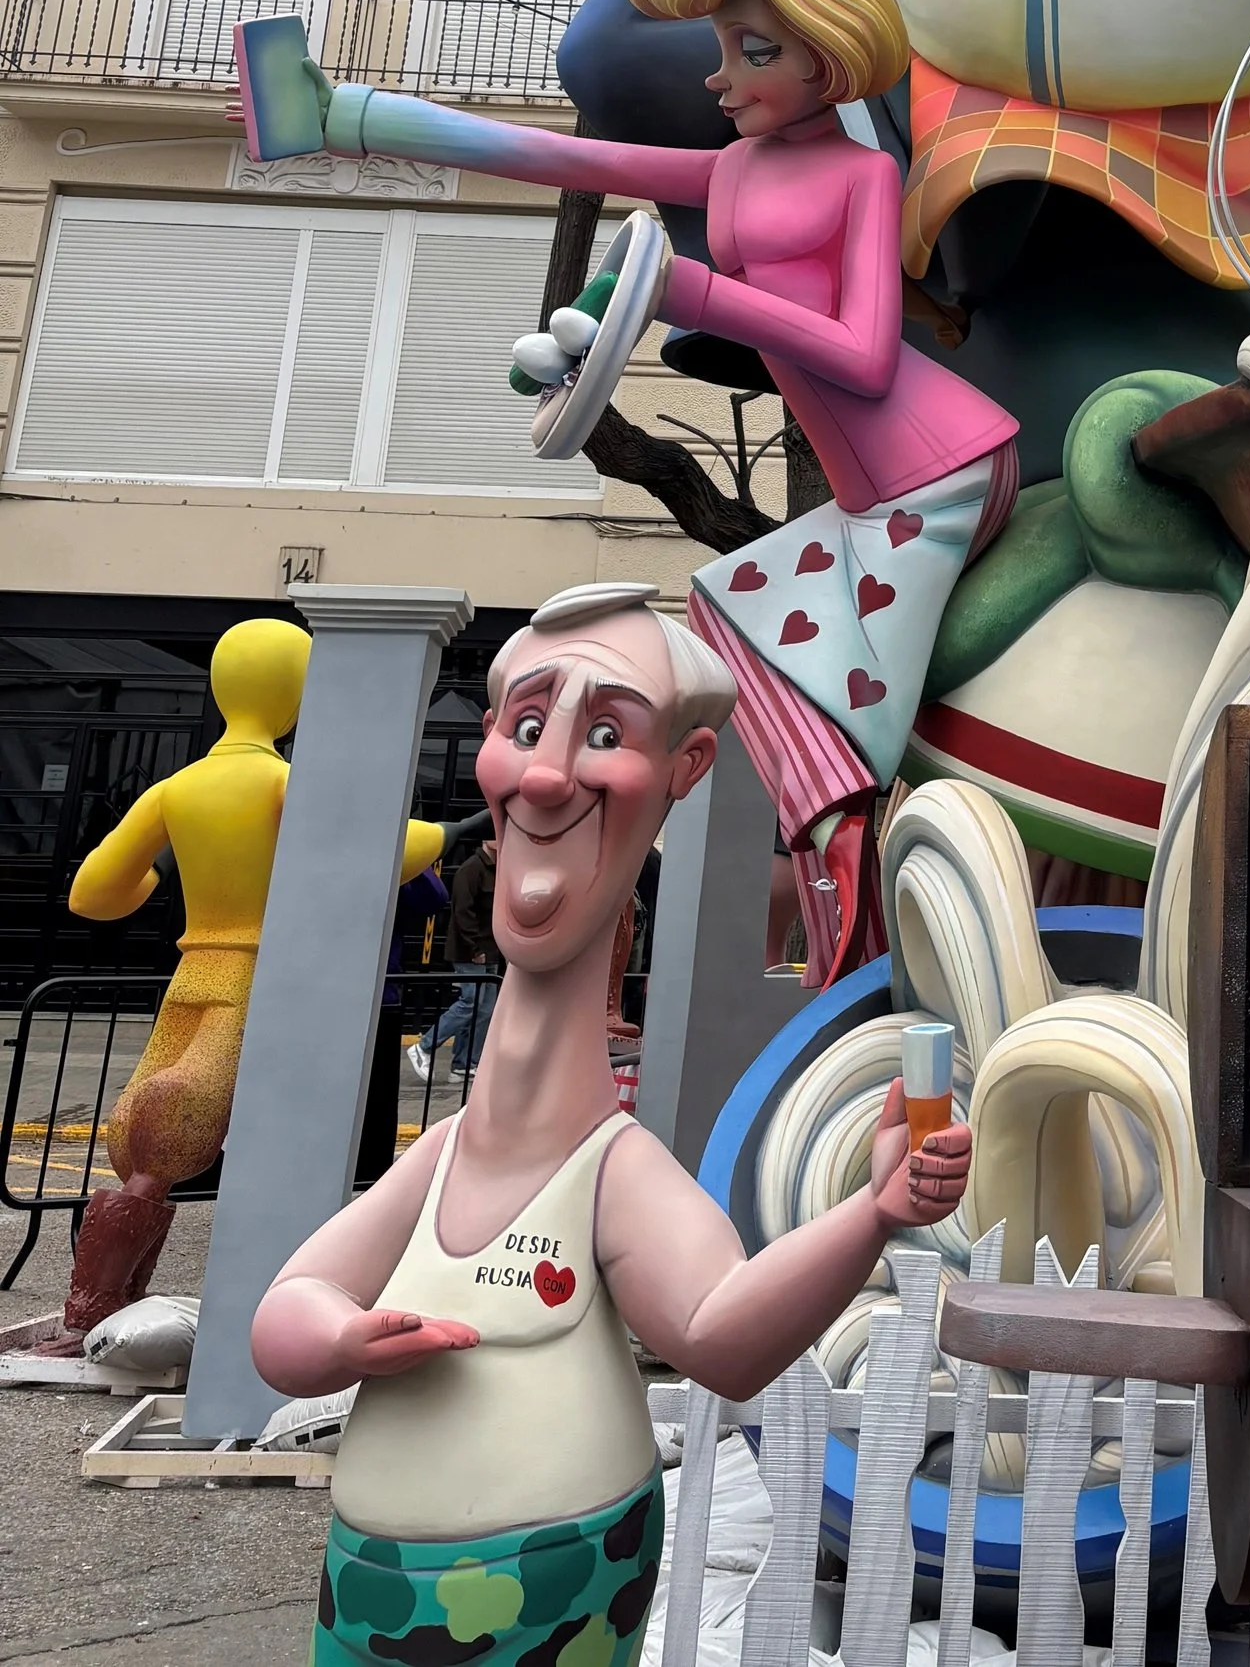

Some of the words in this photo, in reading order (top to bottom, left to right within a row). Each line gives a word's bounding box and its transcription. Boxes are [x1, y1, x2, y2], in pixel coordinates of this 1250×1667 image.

[282, 557, 314, 584] 14
[505, 1233, 561, 1259] DESDE
[475, 1266, 532, 1290] RUSIA
[543, 1277, 566, 1294] CON
